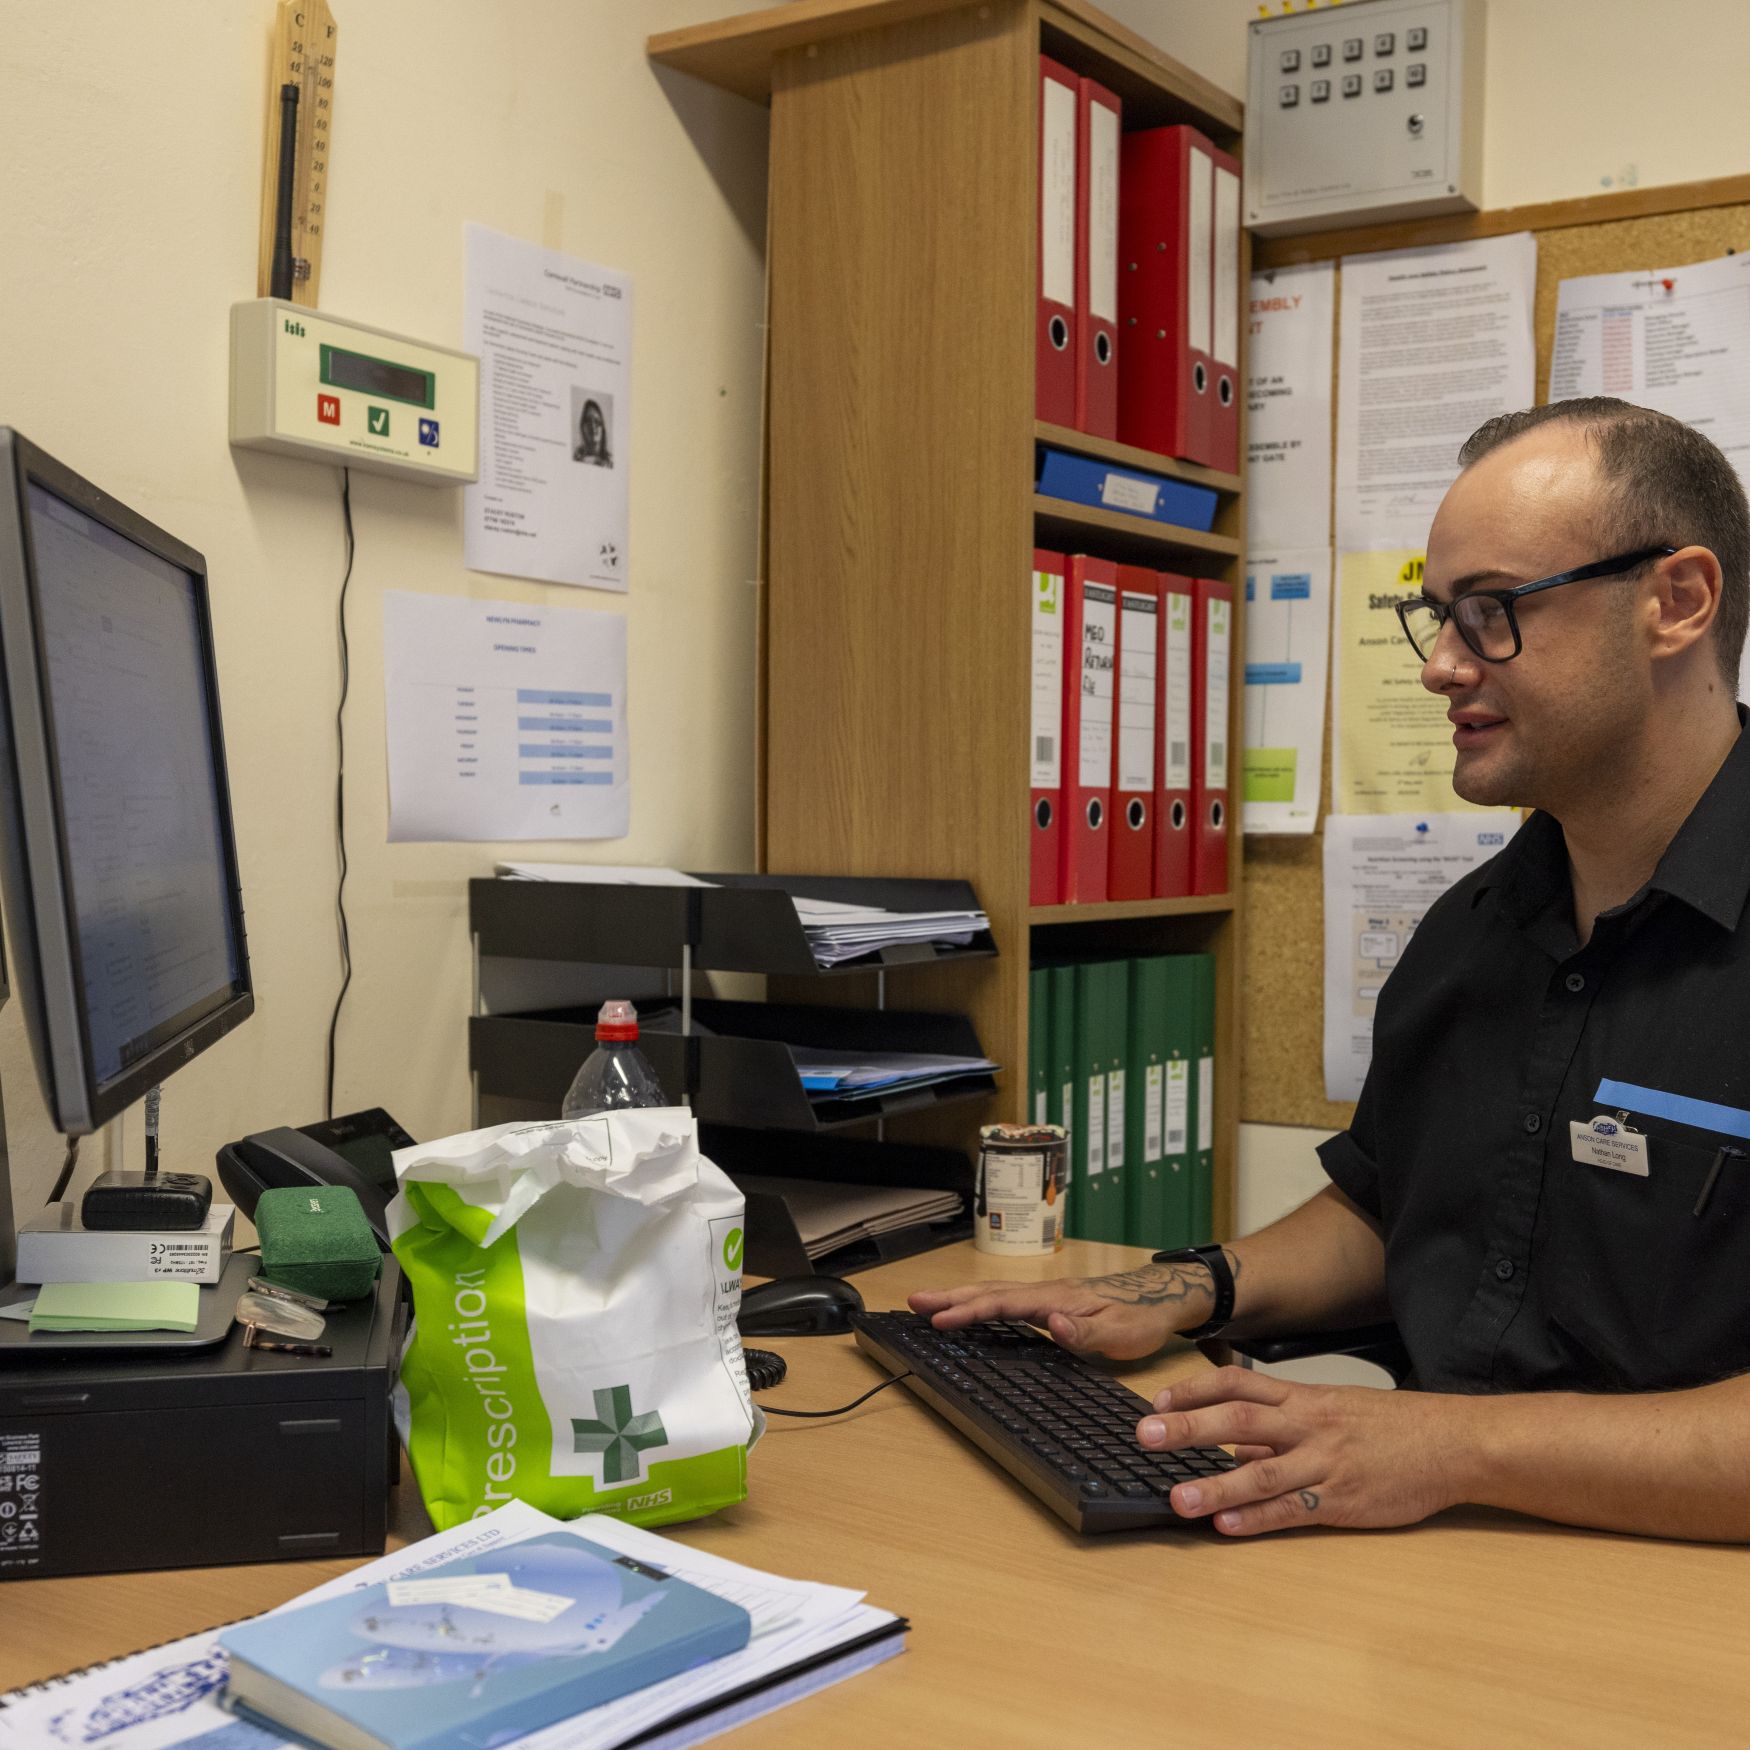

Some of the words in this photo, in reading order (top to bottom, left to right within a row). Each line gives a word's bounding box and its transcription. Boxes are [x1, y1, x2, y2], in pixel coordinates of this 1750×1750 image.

[295, 13, 305, 27] C
[326, 25, 335, 38] F
[292, 41, 303, 53] 50
[290, 61, 301, 72] 40
[320, 55, 334, 67] 120
[318, 76, 332, 88] 100
[313, 160, 325, 171] 20
[323, 402, 335, 418] M
[1577, 1133, 1595, 1144] ANSON
[1596, 1137, 1610, 1147] CARE
[1611, 1140, 1639, 1152] SERVICES
[1592, 1147, 1611, 1157] Nathan
[1612, 1151, 1626, 1163] Long
[630, 1490, 669, 1509] NHS
[390, 1562, 424, 1584] CARE
[422, 1539, 478, 1569] SERVICES
[479, 1528, 500, 1542] LTD
